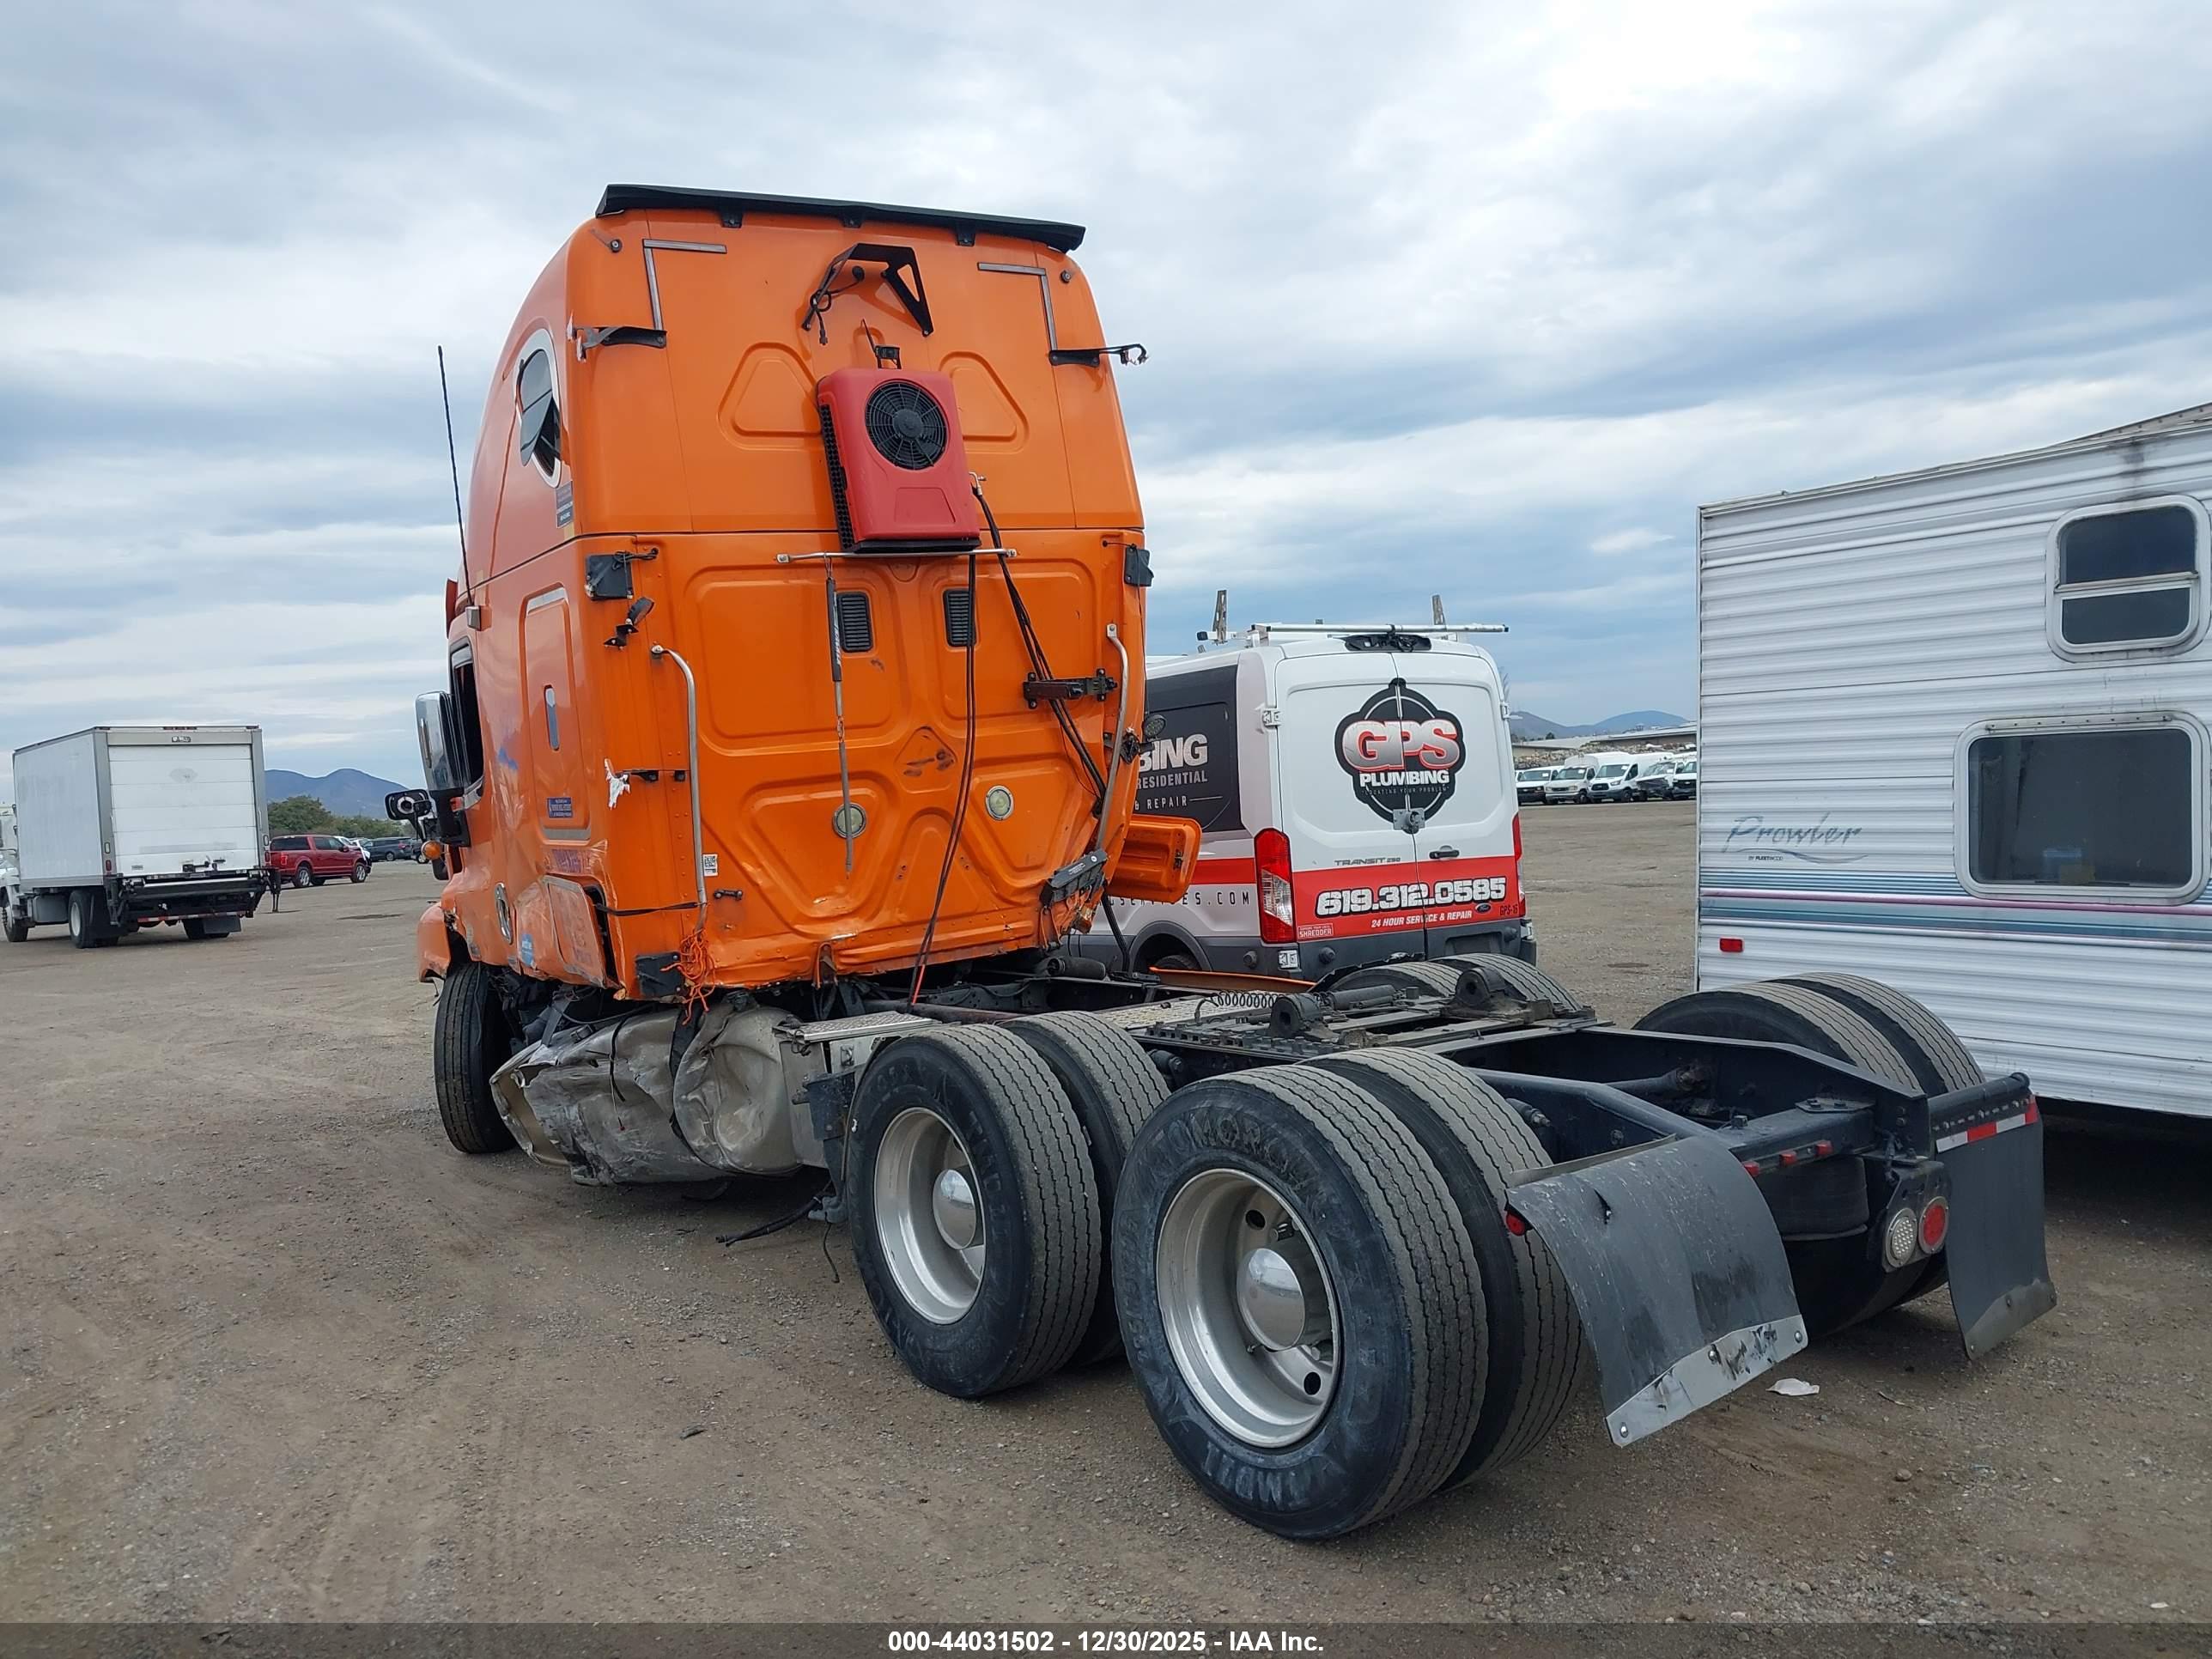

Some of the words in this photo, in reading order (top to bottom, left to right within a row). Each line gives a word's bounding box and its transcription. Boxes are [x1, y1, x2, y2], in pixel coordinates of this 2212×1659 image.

[1342, 719, 1460, 772] GPS
[1136, 770, 1208, 790] RESIDENTIAL
[1359, 769, 1449, 787] PLUMBING
[1146, 795, 1187, 810] REPAIR
[1722, 811, 1863, 853] Prowler
[1334, 858, 1385, 866] TRANSIT
[1316, 877, 1506, 917] 619.312.0585
[1371, 919, 1382, 928] 24
[1382, 916, 1404, 927] HOUR
[1406, 913, 1438, 925] SERVICE
[1446, 910, 1472, 921] REPAIR
[1299, 928, 1332, 937] SHREDDER
